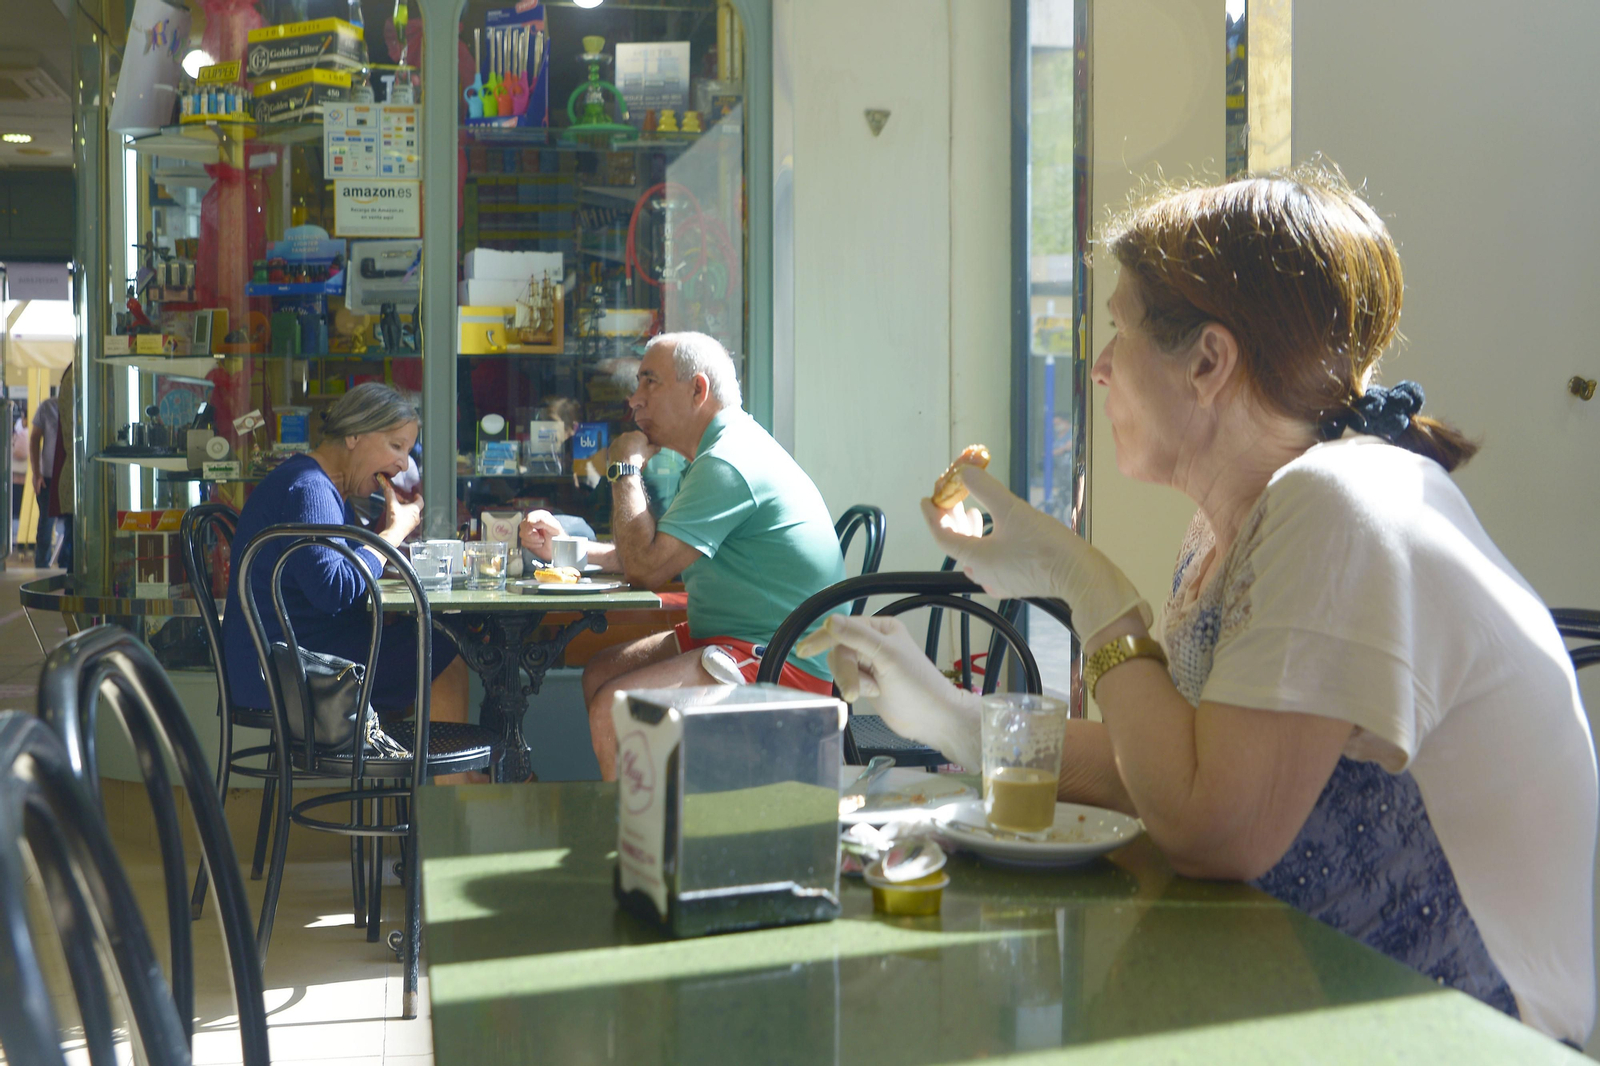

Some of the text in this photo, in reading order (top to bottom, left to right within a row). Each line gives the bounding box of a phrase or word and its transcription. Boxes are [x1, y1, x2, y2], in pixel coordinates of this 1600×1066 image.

[270, 44, 320, 59] Golden Filter
[202, 66, 236, 79] CLIPPER
[343, 186, 412, 199] amazon.es
[580, 436, 596, 448] blu
